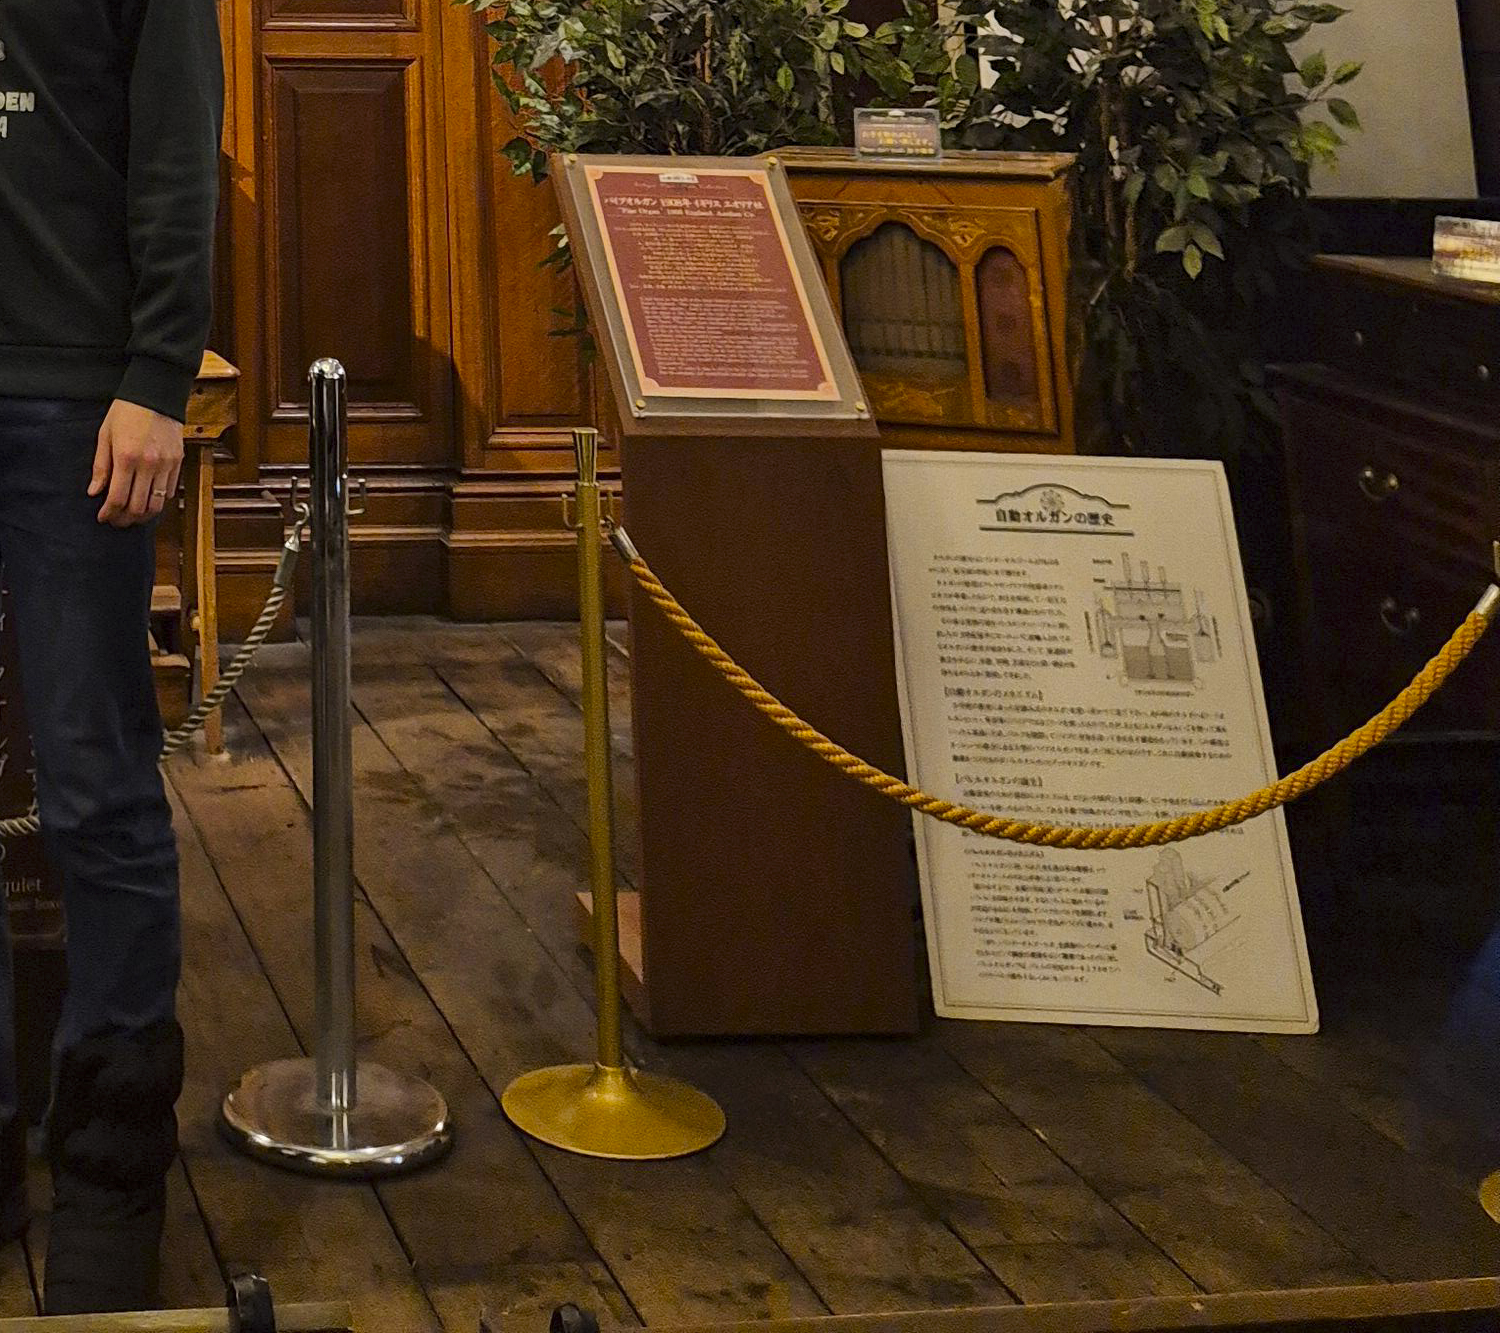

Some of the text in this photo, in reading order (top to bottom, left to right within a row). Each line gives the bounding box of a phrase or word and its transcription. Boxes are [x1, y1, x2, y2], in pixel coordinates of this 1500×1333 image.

[995, 508, 1115, 526] 自動オルガンの歴史
